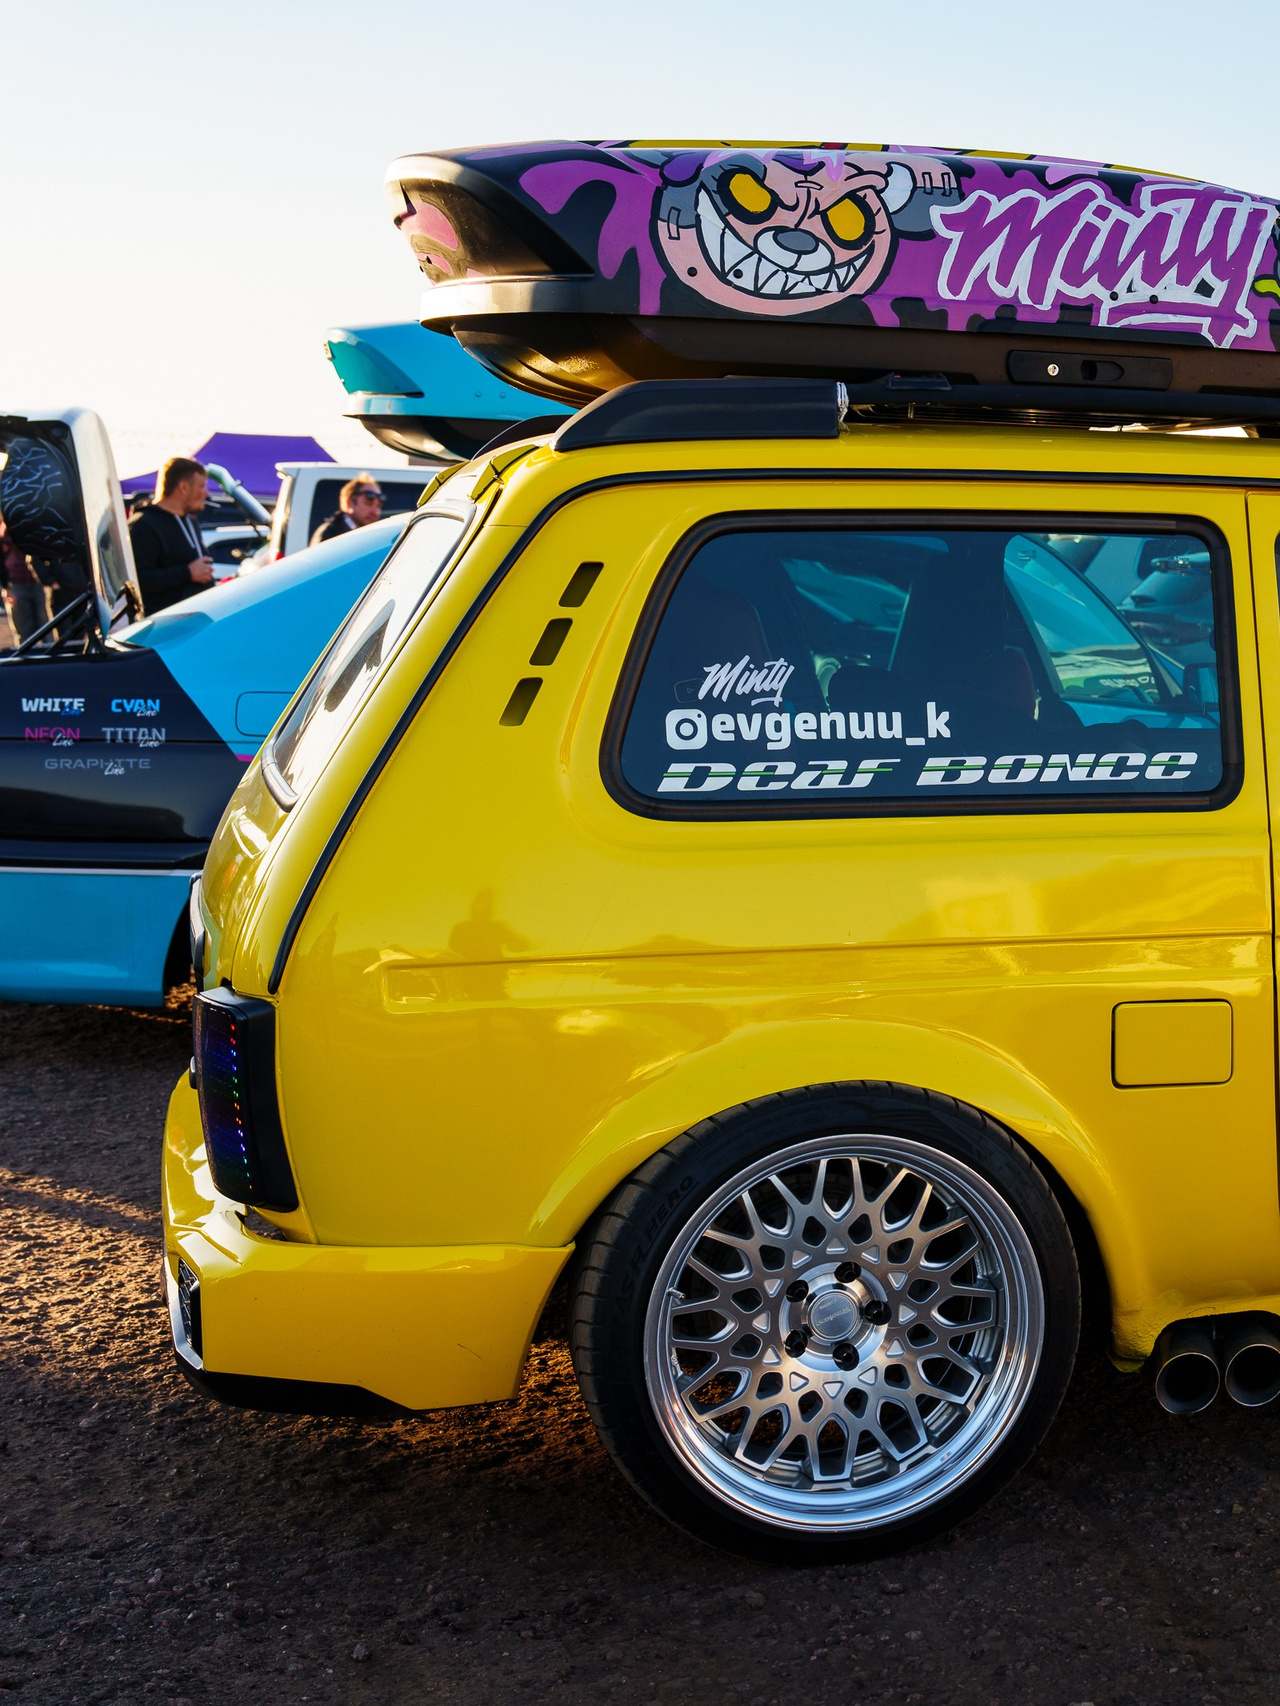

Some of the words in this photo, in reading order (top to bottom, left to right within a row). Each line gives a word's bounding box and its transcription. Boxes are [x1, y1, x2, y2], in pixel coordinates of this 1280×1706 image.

[698, 655, 795, 707] Minty
[21, 698, 85, 712] WHITE
[111, 699, 160, 713] CYAN
[136, 705, 158, 717] Line
[25, 727, 80, 742] NEON
[52, 733, 75, 747] Line
[101, 727, 166, 743] TITAN
[139, 734, 161, 748] Line
[44, 758, 151, 770] GRAPHITE
[104, 762, 126, 776] Line
